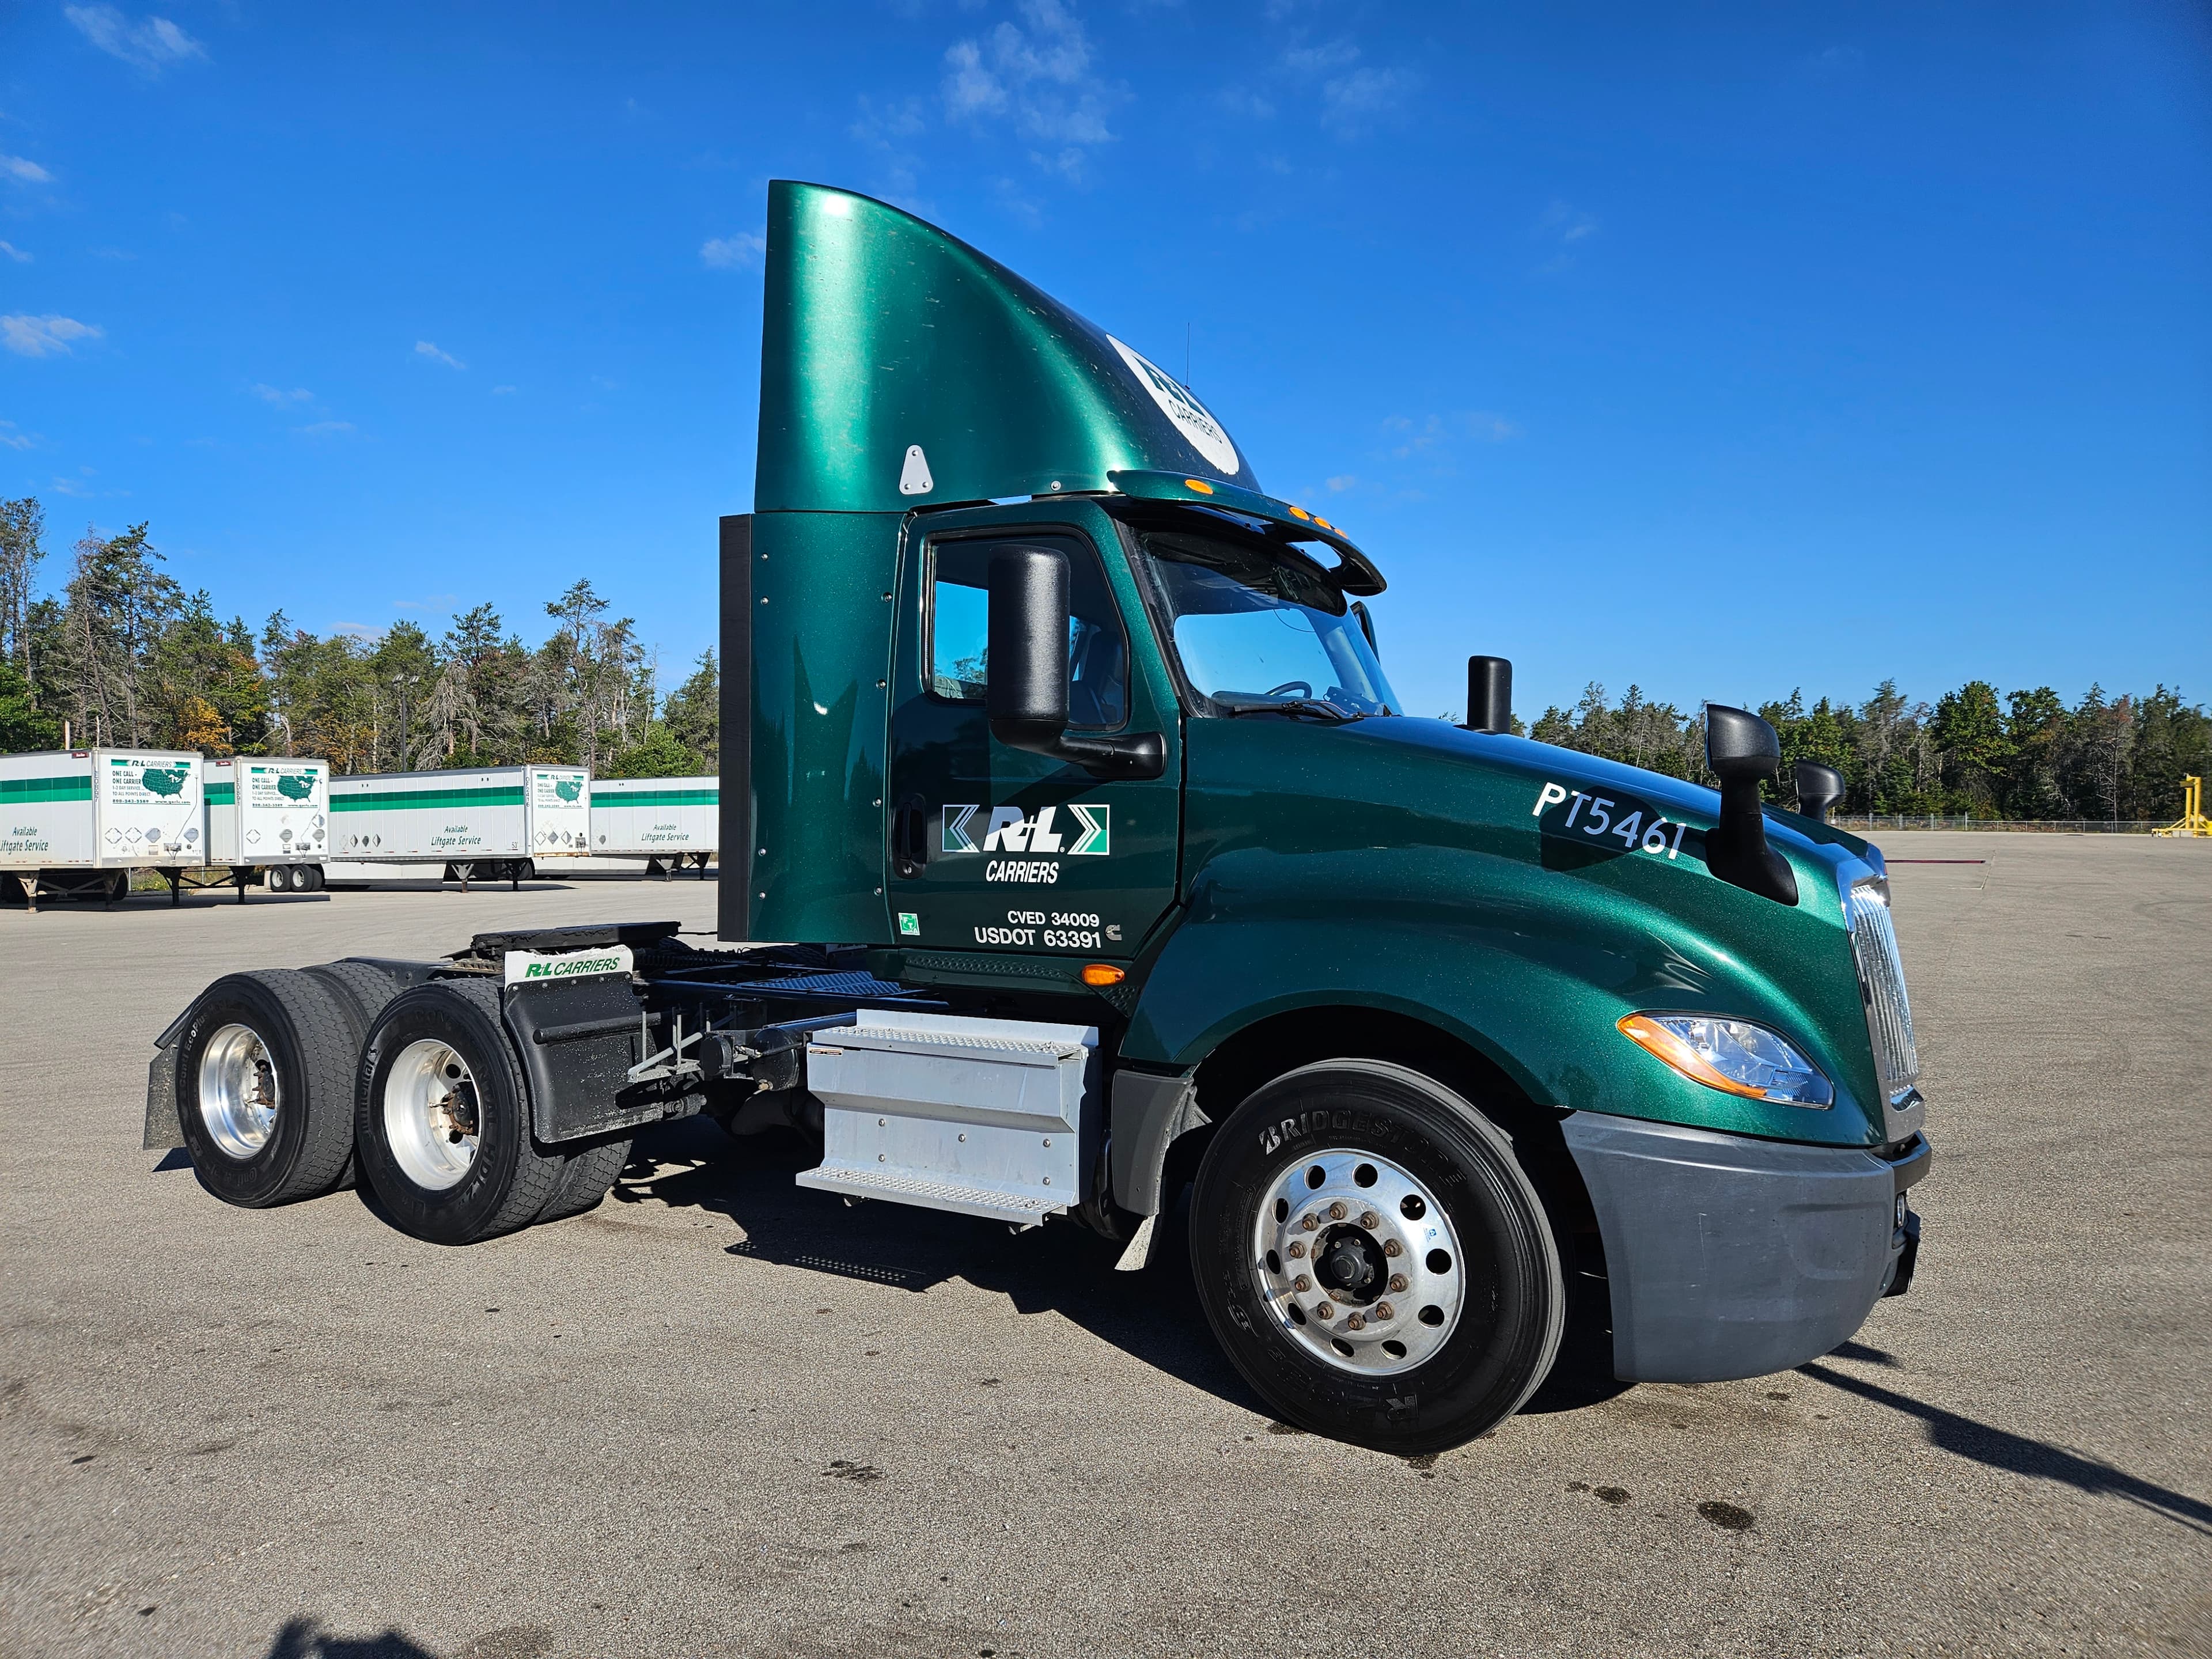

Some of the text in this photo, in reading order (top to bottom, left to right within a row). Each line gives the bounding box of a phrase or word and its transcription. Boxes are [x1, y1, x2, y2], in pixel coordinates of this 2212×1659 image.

[1168, 399, 1223, 444] CARRIERS
[444, 825, 468, 833] Available
[1532, 782, 1687, 860] PT5461
[12, 826, 37, 836] Available
[641, 832, 690, 843] Liftgate Service
[25, 839, 48, 851] Service
[431, 835, 481, 849] Liftgate Service
[986, 859, 1059, 884] CARRIERS
[1007, 910, 1100, 927] CVED 34009
[974, 926, 1036, 946] USDOT
[1043, 929, 1101, 949] 63391
[554, 957, 620, 976] CARRIERS
[186, 1012, 209, 1052] EcoPlus
[1257, 1109, 1468, 1188] BRIDGESTONE
